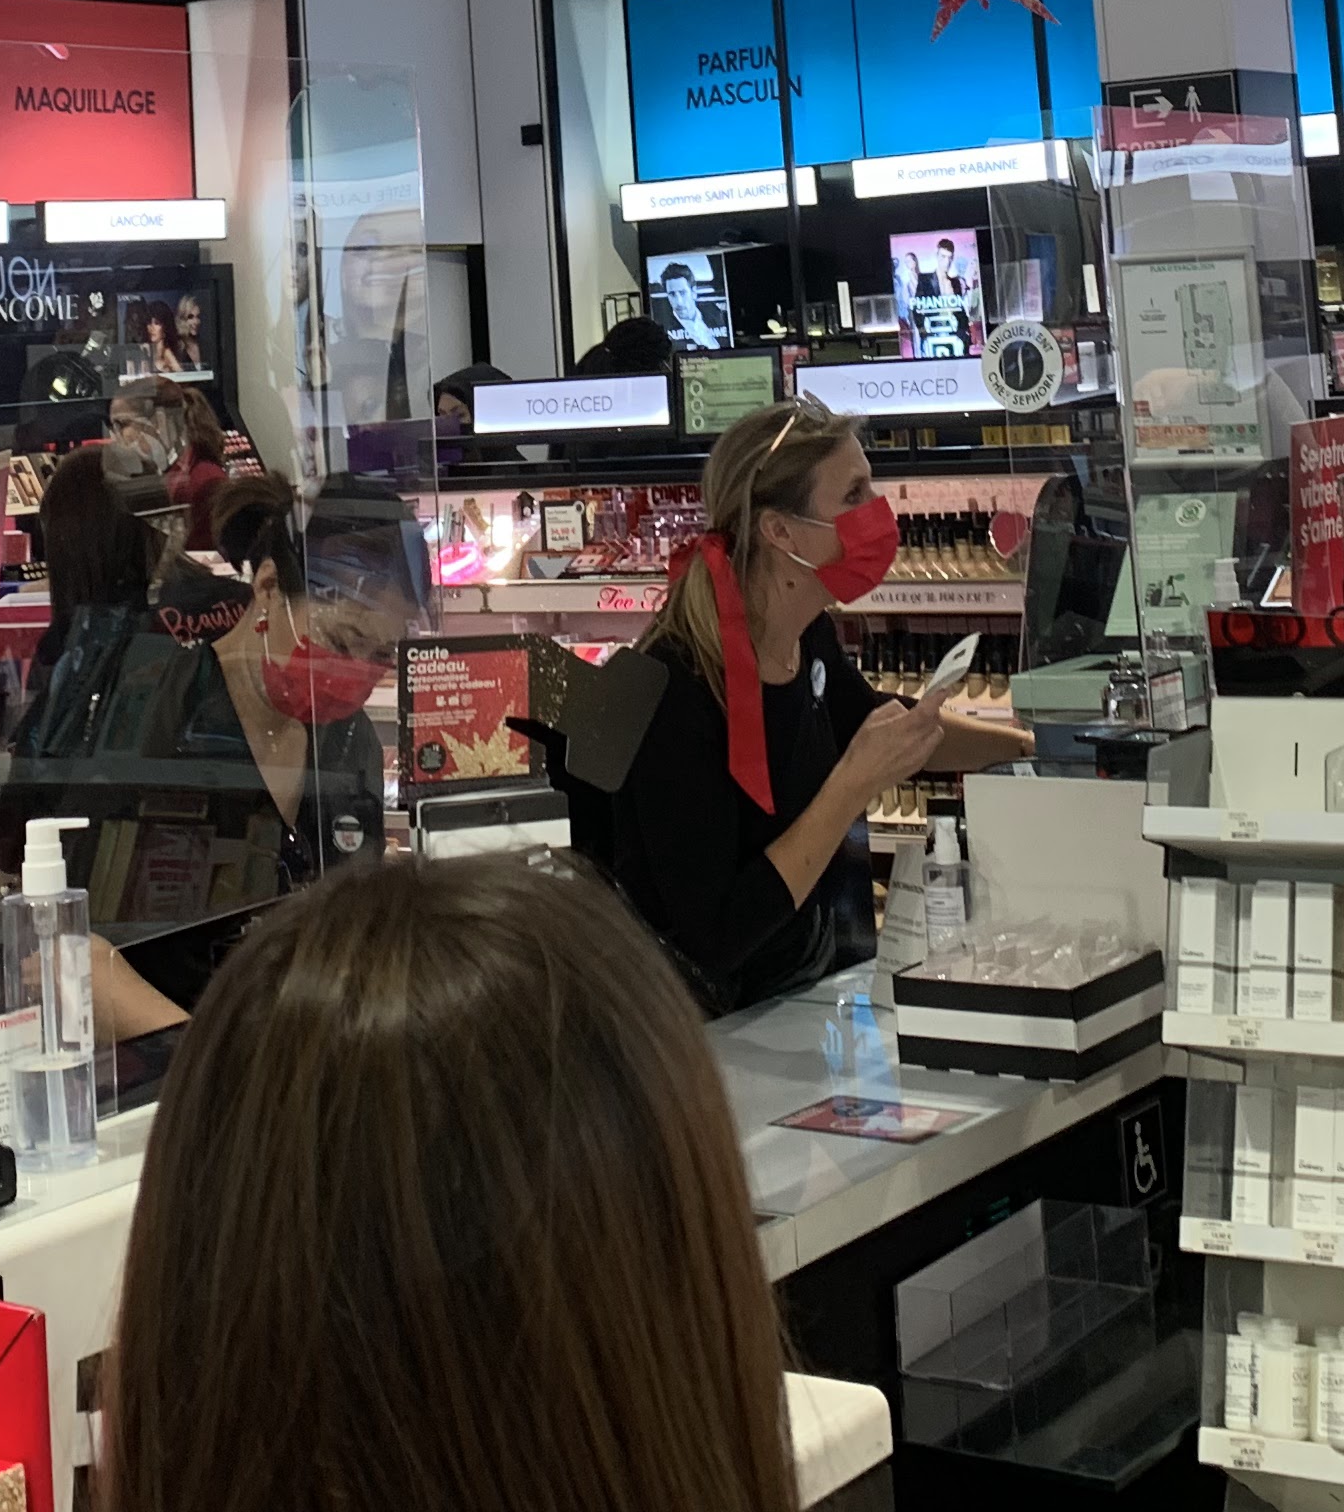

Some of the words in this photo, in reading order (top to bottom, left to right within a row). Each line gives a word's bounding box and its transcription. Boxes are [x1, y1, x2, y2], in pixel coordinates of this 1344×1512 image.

[14, 87, 156, 115] MAQUILLAGE
[908, 166, 956, 179] comme
[959, 158, 1019, 175] RABANNE
[659, 192, 702, 207] comme
[705, 187, 735, 202] SAINT
[909, 295, 970, 310] PHANTOM
[857, 381, 896, 400] TOO
[900, 377, 959, 398] FACED
[1012, 373, 1056, 406] SEPHORA
[526, 399, 560, 415] TOO
[563, 394, 614, 414] FACED
[1300, 445, 1320, 472] Se
[407, 646, 449, 662] Carte
[407, 660, 470, 675] cadeau.
[432, 682, 458, 691] carte
